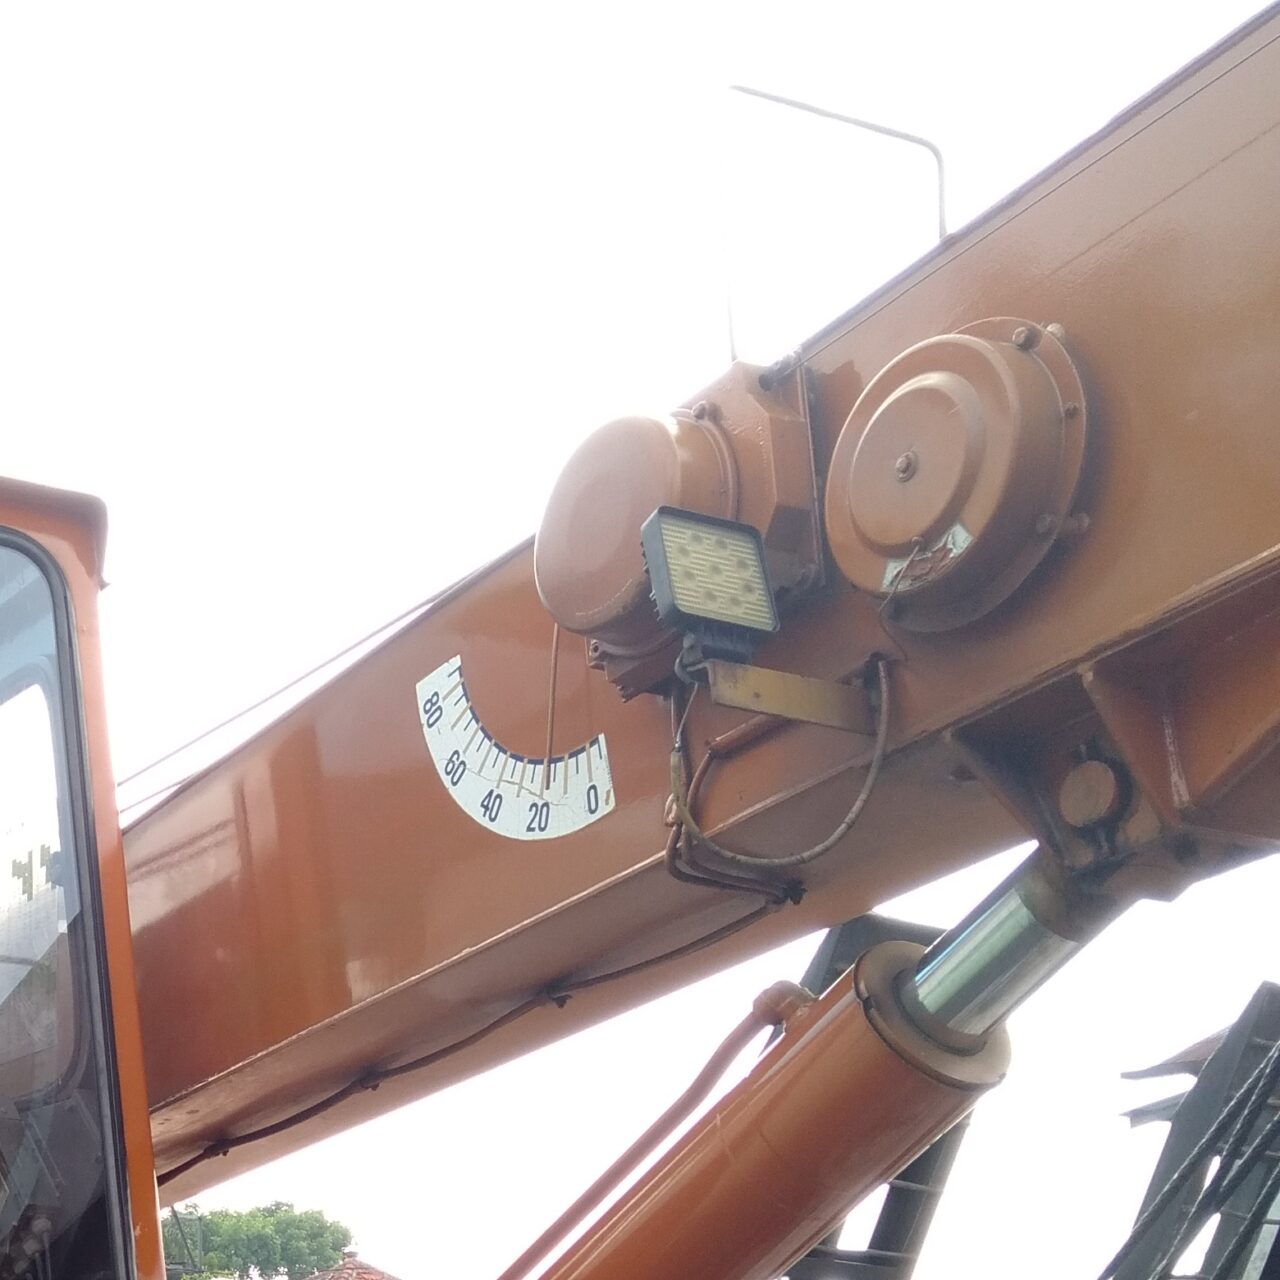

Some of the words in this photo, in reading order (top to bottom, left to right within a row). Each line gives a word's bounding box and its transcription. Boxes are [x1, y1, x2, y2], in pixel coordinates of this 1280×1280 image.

[423, 691, 443, 728] 80
[444, 750, 467, 786] 60
[480, 789, 503, 823] 40
[526, 802, 550, 832] 20
[586, 784, 599, 815] 0
